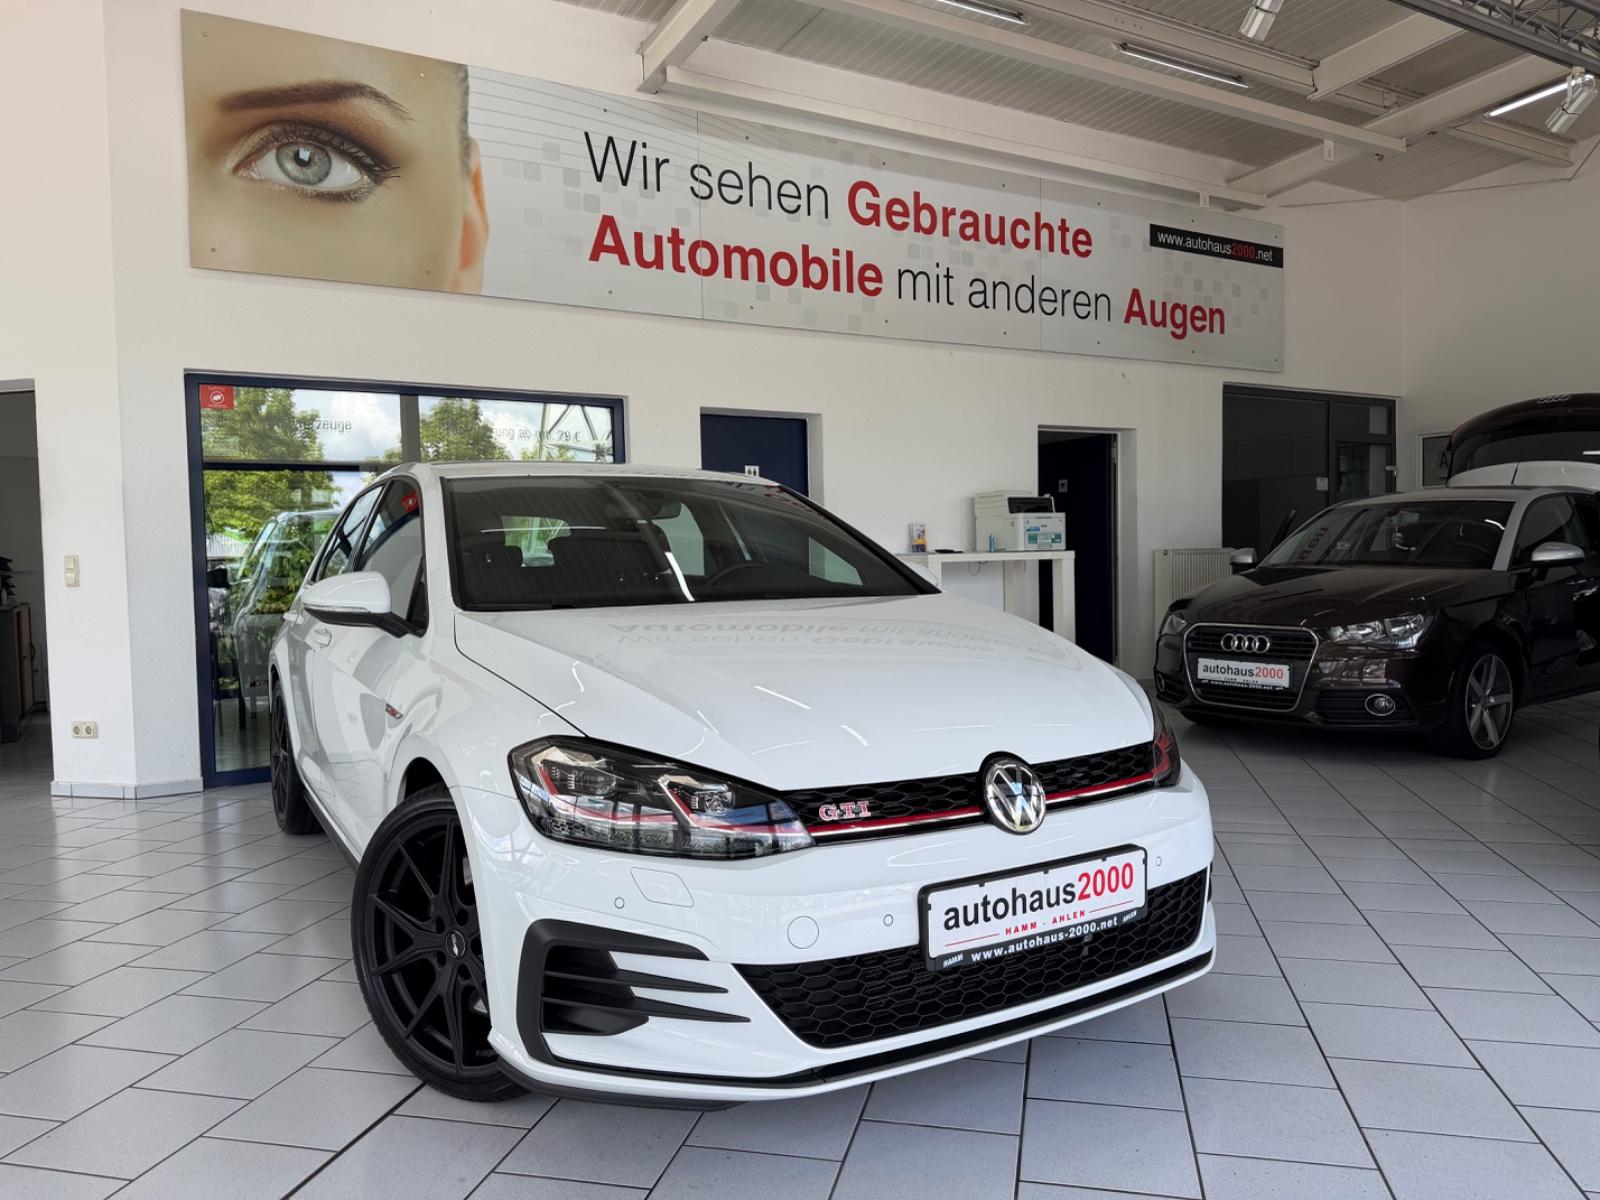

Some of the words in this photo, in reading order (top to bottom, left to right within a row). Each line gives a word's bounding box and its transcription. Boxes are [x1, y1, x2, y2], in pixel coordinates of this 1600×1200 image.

[582, 130, 670, 192] Wir
[688, 161, 830, 220] sehen
[847, 180, 1093, 259] Gebrauchte
[1156, 230, 1273, 262] www.autohaus2000.net
[588, 214, 883, 298] Automobile
[896, 263, 954, 306] mit
[968, 275, 1112, 323] anderen
[1123, 288, 1227, 341] Augen
[1202, 662, 1284, 679] autohaus2000
[818, 801, 871, 821] GTI
[943, 862, 1134, 931] autohaus2000
[970, 917, 1118, 962] www.autohaus-2000.net
[1005, 921, 1038, 936] HAMM
[1052, 909, 1086, 925] AHLEN
